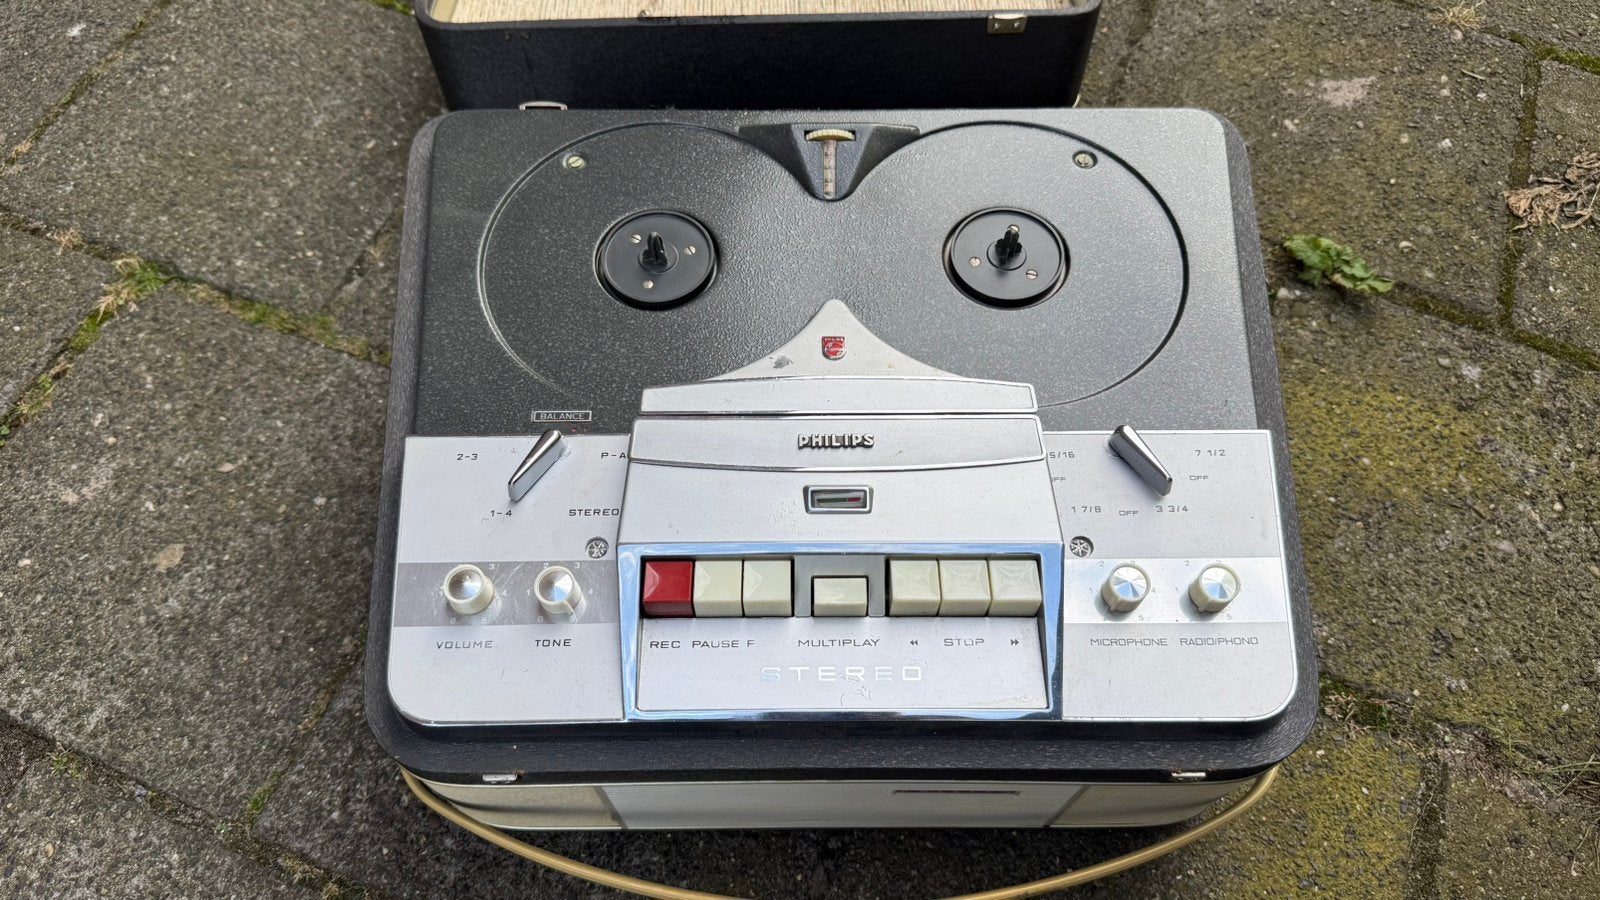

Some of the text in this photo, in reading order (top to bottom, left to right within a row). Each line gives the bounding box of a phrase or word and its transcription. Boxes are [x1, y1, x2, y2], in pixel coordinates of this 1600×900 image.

[540, 412, 585, 420] BALANCE
[798, 433, 874, 449] PHILIPS
[456, 453, 479, 461] 2-3
[1195, 449, 1226, 457] 7 1/2
[490, 509, 513, 517] 1-4
[568, 508, 620, 517] STEREO
[1082, 505, 1102, 513] 7/8
[1155, 505, 1189, 513] 3 3/4
[436, 640, 494, 649] VOLUME
[535, 639, 572, 647] TONE
[692, 640, 739, 648] PAUSE
[798, 638, 880, 647] MULTIPLAY
[943, 638, 985, 646] STOP
[1090, 638, 1169, 647] MICROPHONE
[1180, 637, 1259, 646] RADIO/PHONO
[761, 666, 923, 682] STEREO
